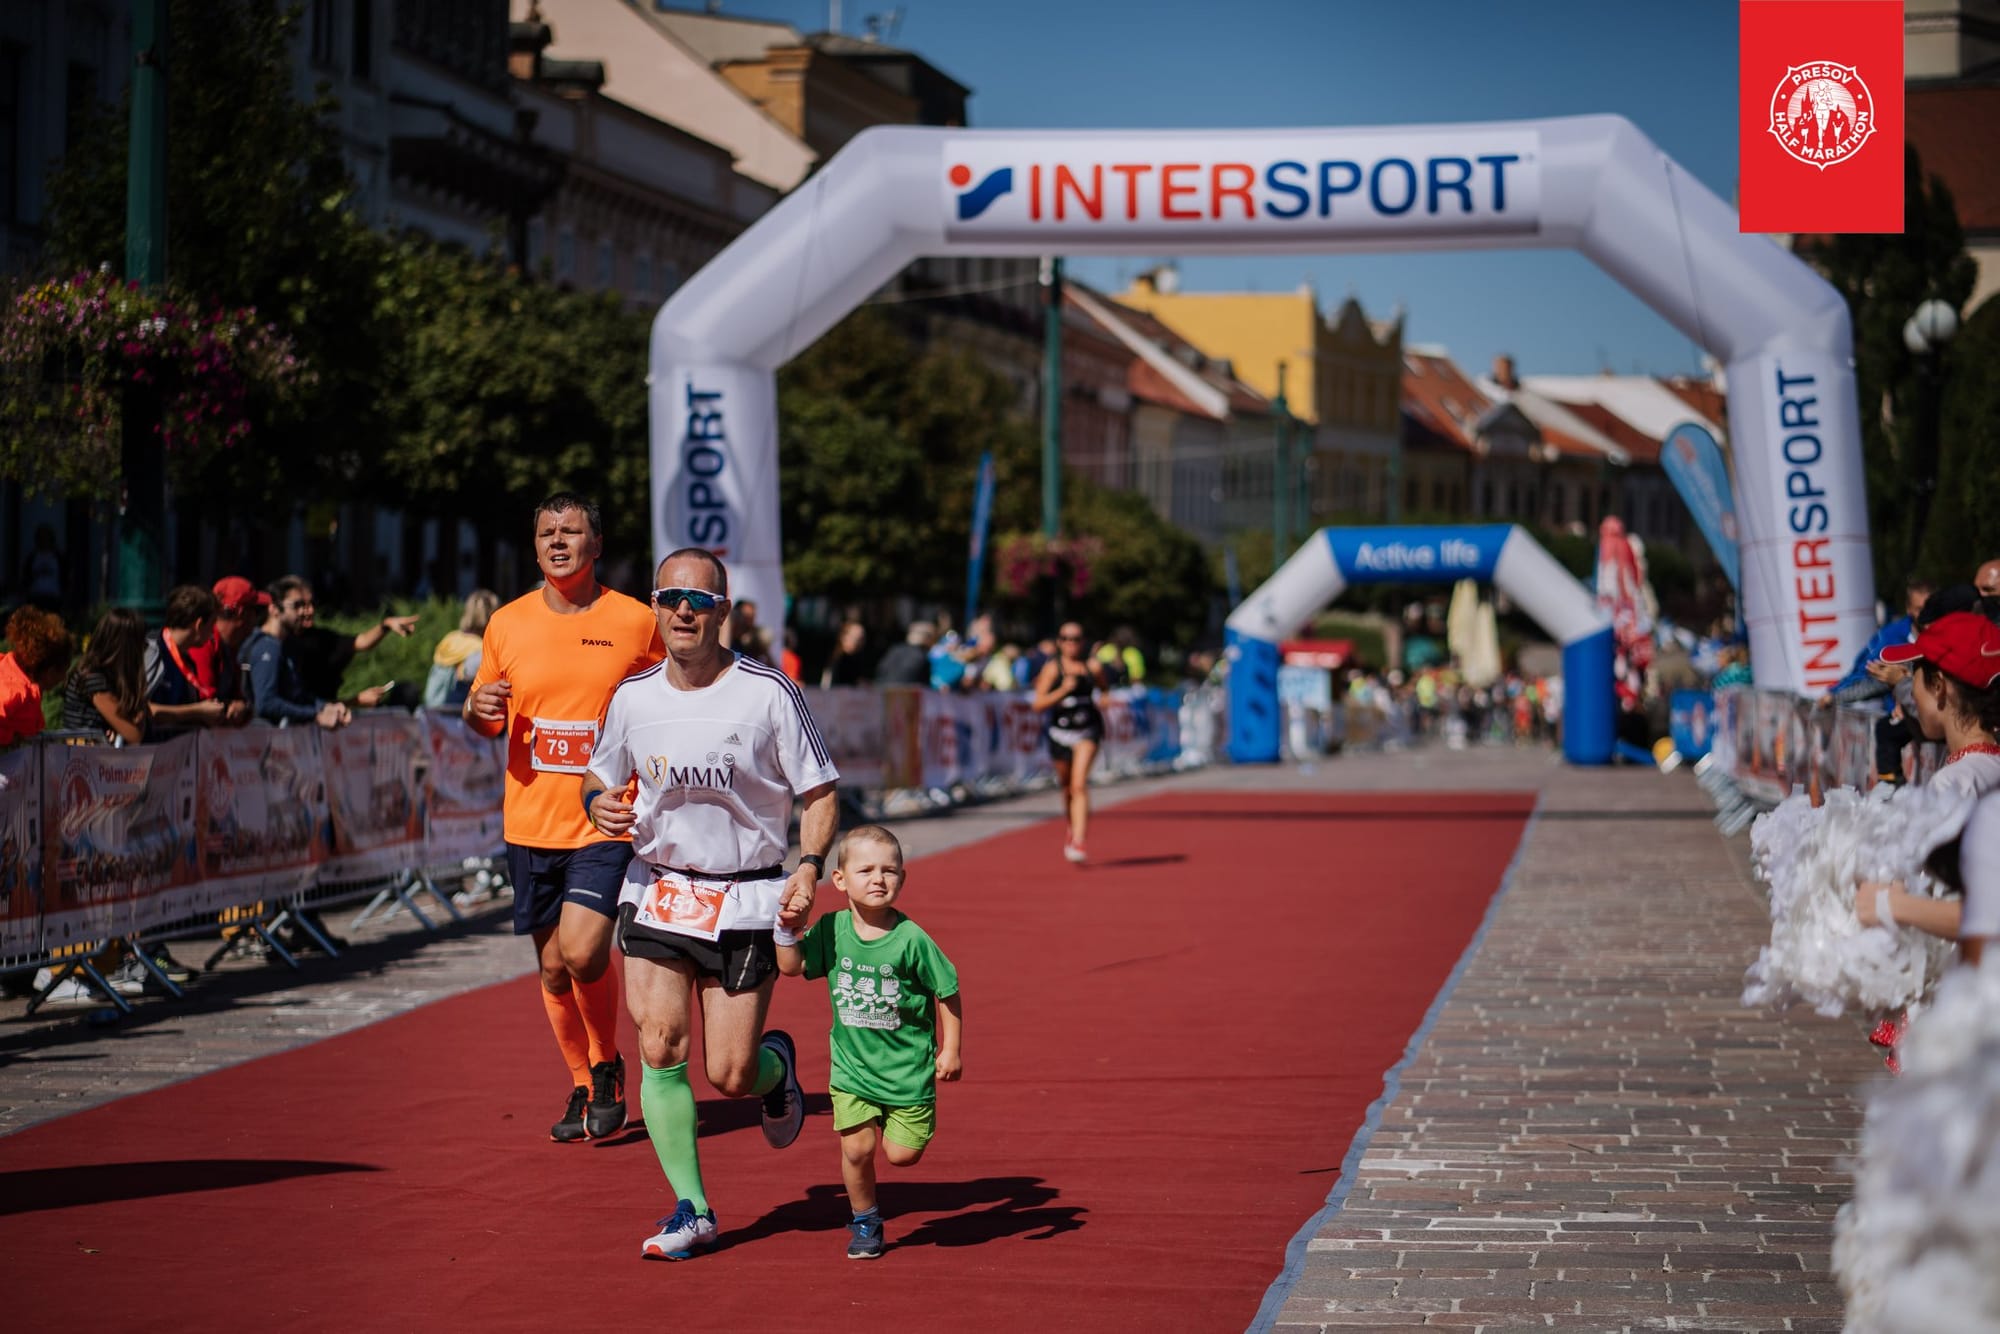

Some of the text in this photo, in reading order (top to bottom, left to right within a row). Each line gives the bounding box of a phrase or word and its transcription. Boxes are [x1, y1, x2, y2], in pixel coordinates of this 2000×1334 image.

[1029, 154, 1520, 222] INTERSPORT
[1776, 368, 1841, 688] INTERSPORT
[1355, 537, 1479, 571] Active life
[581, 639, 614, 647] PAVOL
[546, 738, 569, 756] 79
[670, 766, 734, 789] MMM
